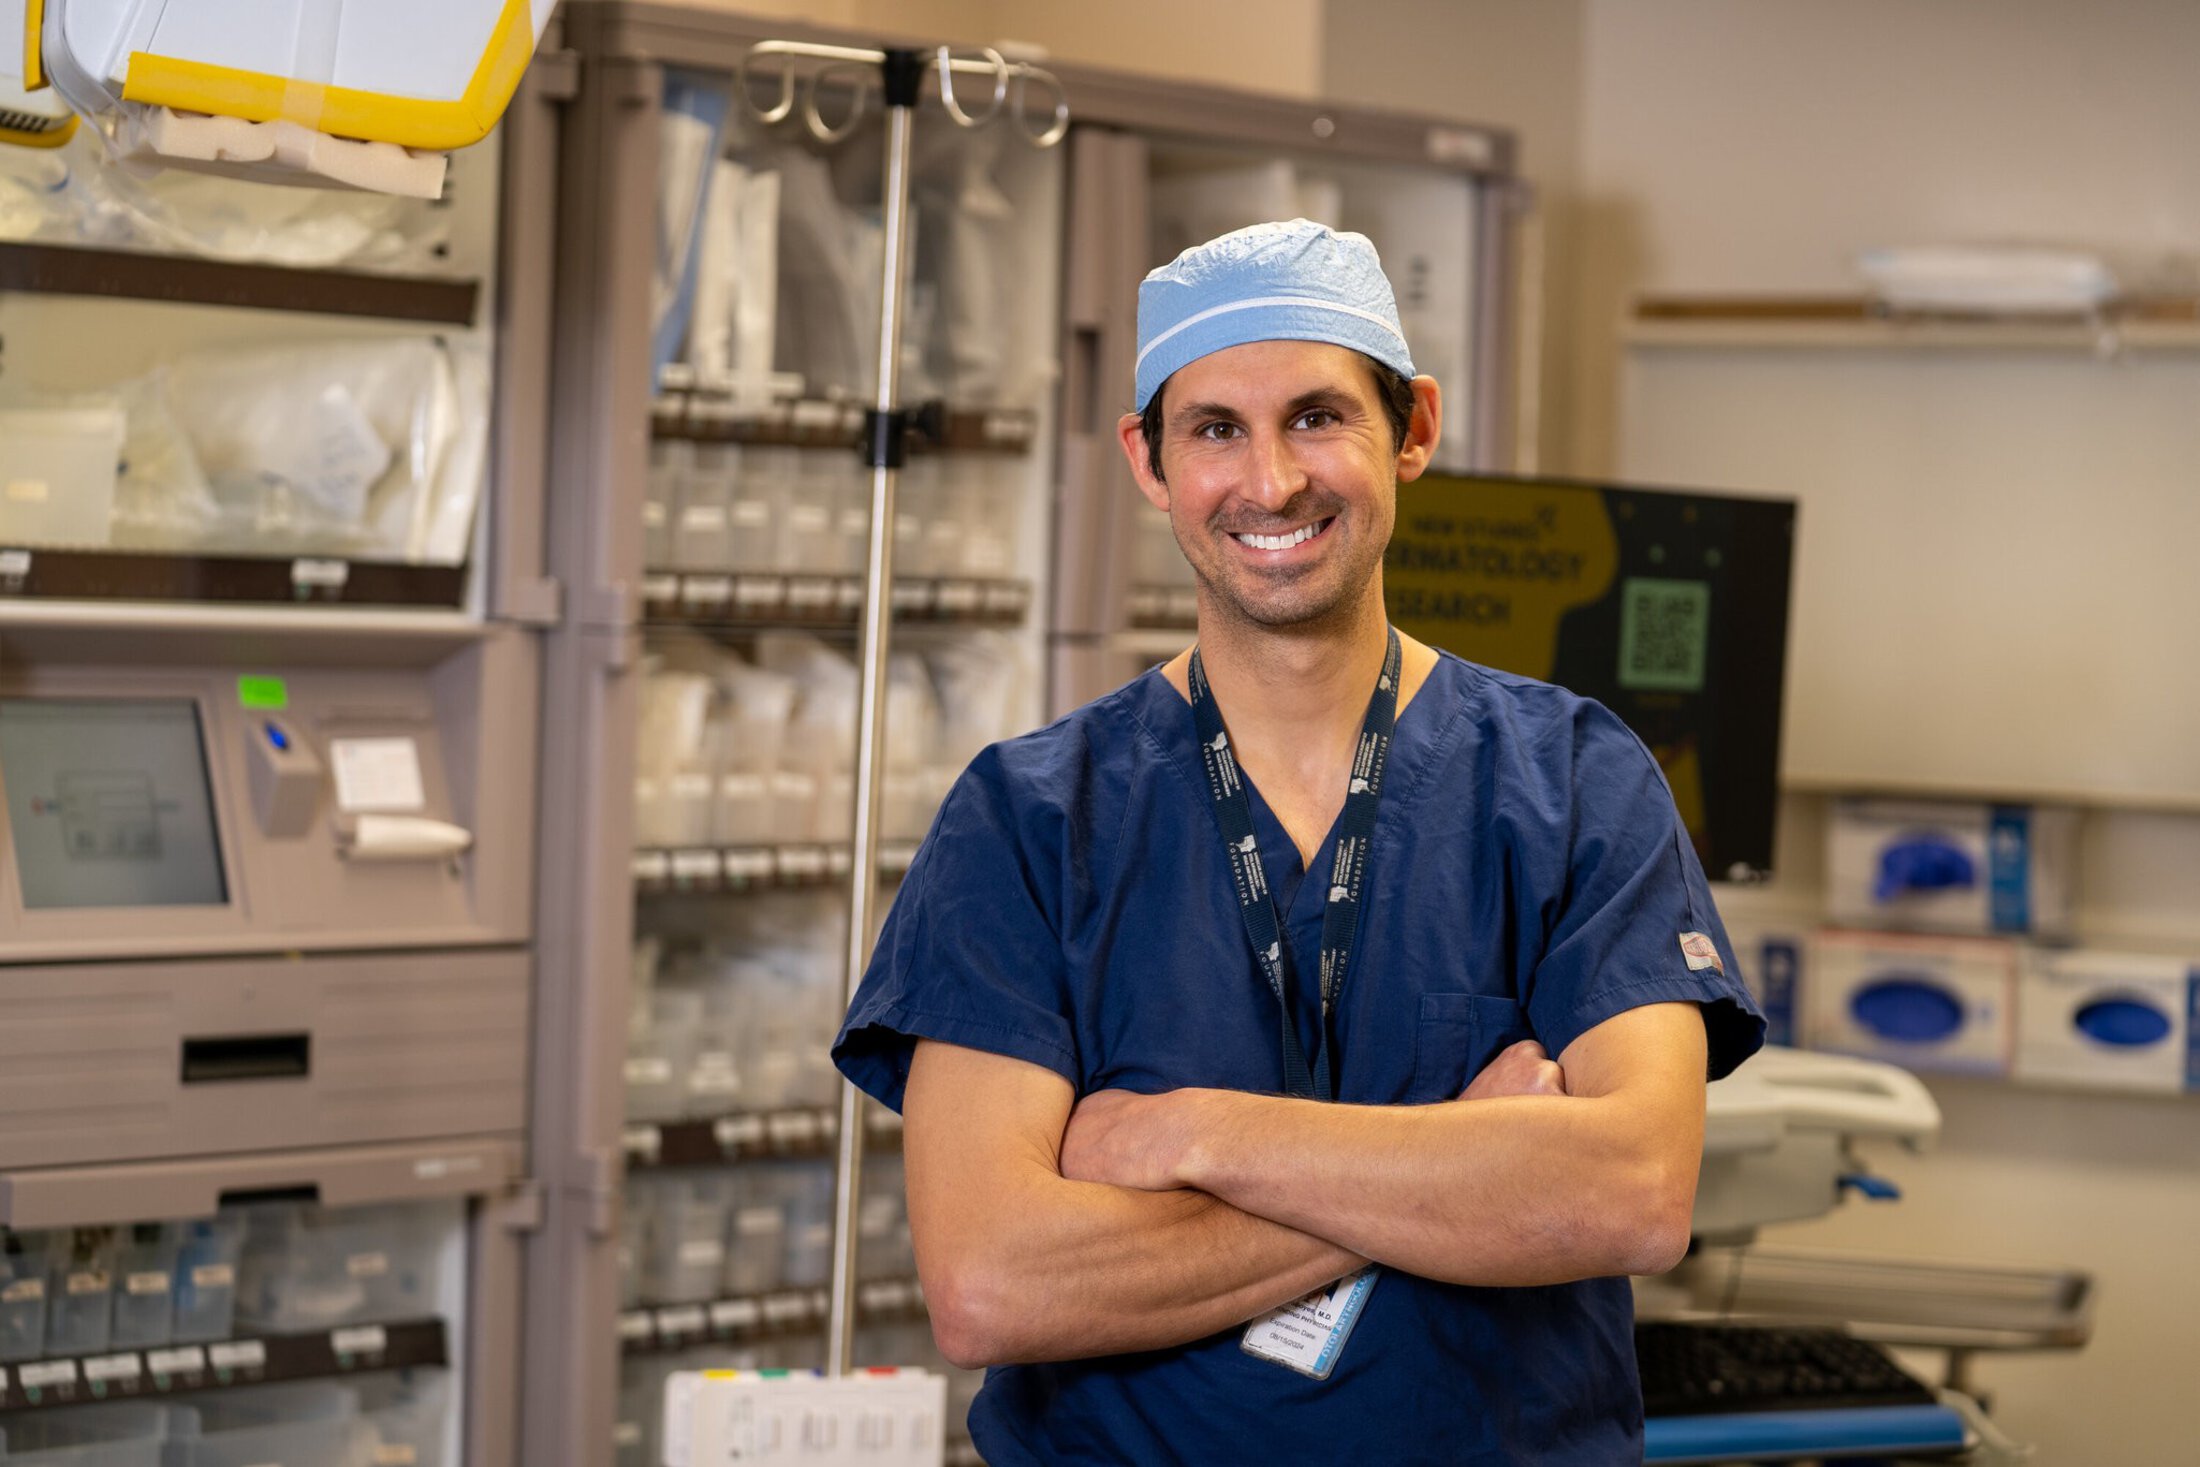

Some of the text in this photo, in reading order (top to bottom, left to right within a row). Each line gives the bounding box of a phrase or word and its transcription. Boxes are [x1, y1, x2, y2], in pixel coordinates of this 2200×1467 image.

[1384, 539, 1586, 580] ERMATOLOGY
[1386, 590, 1511, 626] SEARCH
[1203, 742, 1222, 800] FOUNDATION
[1370, 735, 1388, 795] FOUNDATION
[1228, 841, 1249, 906] FOUNDATION
[1350, 837, 1367, 903] FOUNDATION
[1269, 1317, 1316, 1340] Expiration Date
[1318, 1310, 1333, 1321] M.D.
